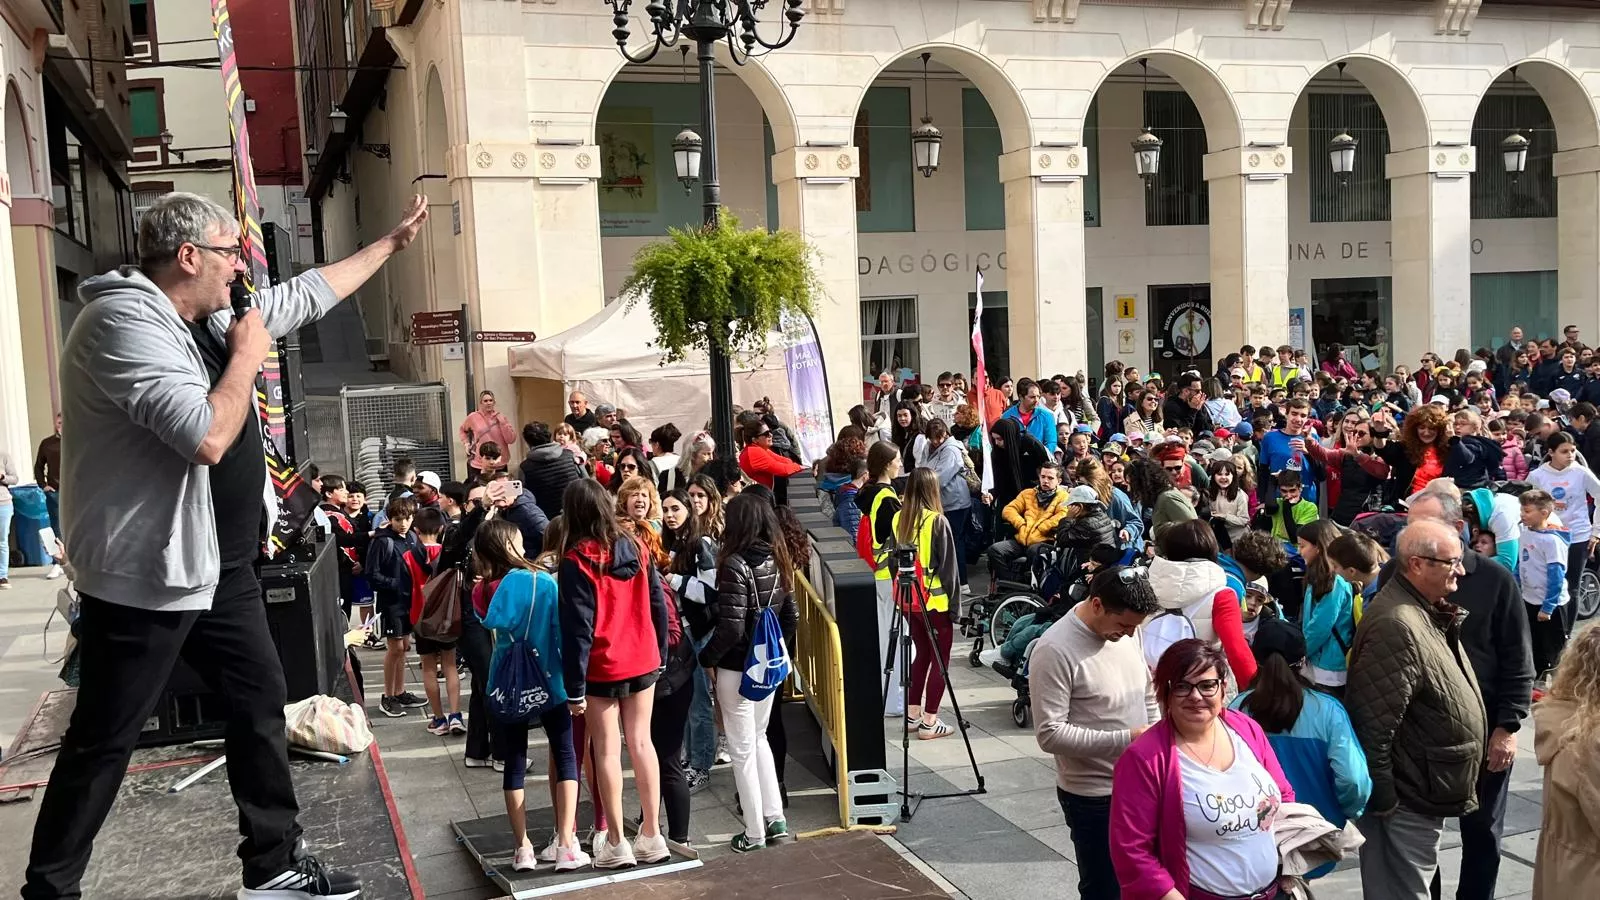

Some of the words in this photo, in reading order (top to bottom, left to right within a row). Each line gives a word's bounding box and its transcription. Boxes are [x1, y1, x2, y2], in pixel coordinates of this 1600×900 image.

[858, 250, 1007, 275] DAGÓGICO
[1289, 242, 1326, 260] INA
[1341, 242, 1369, 259] DE
[1196, 793, 1255, 823] Viva
